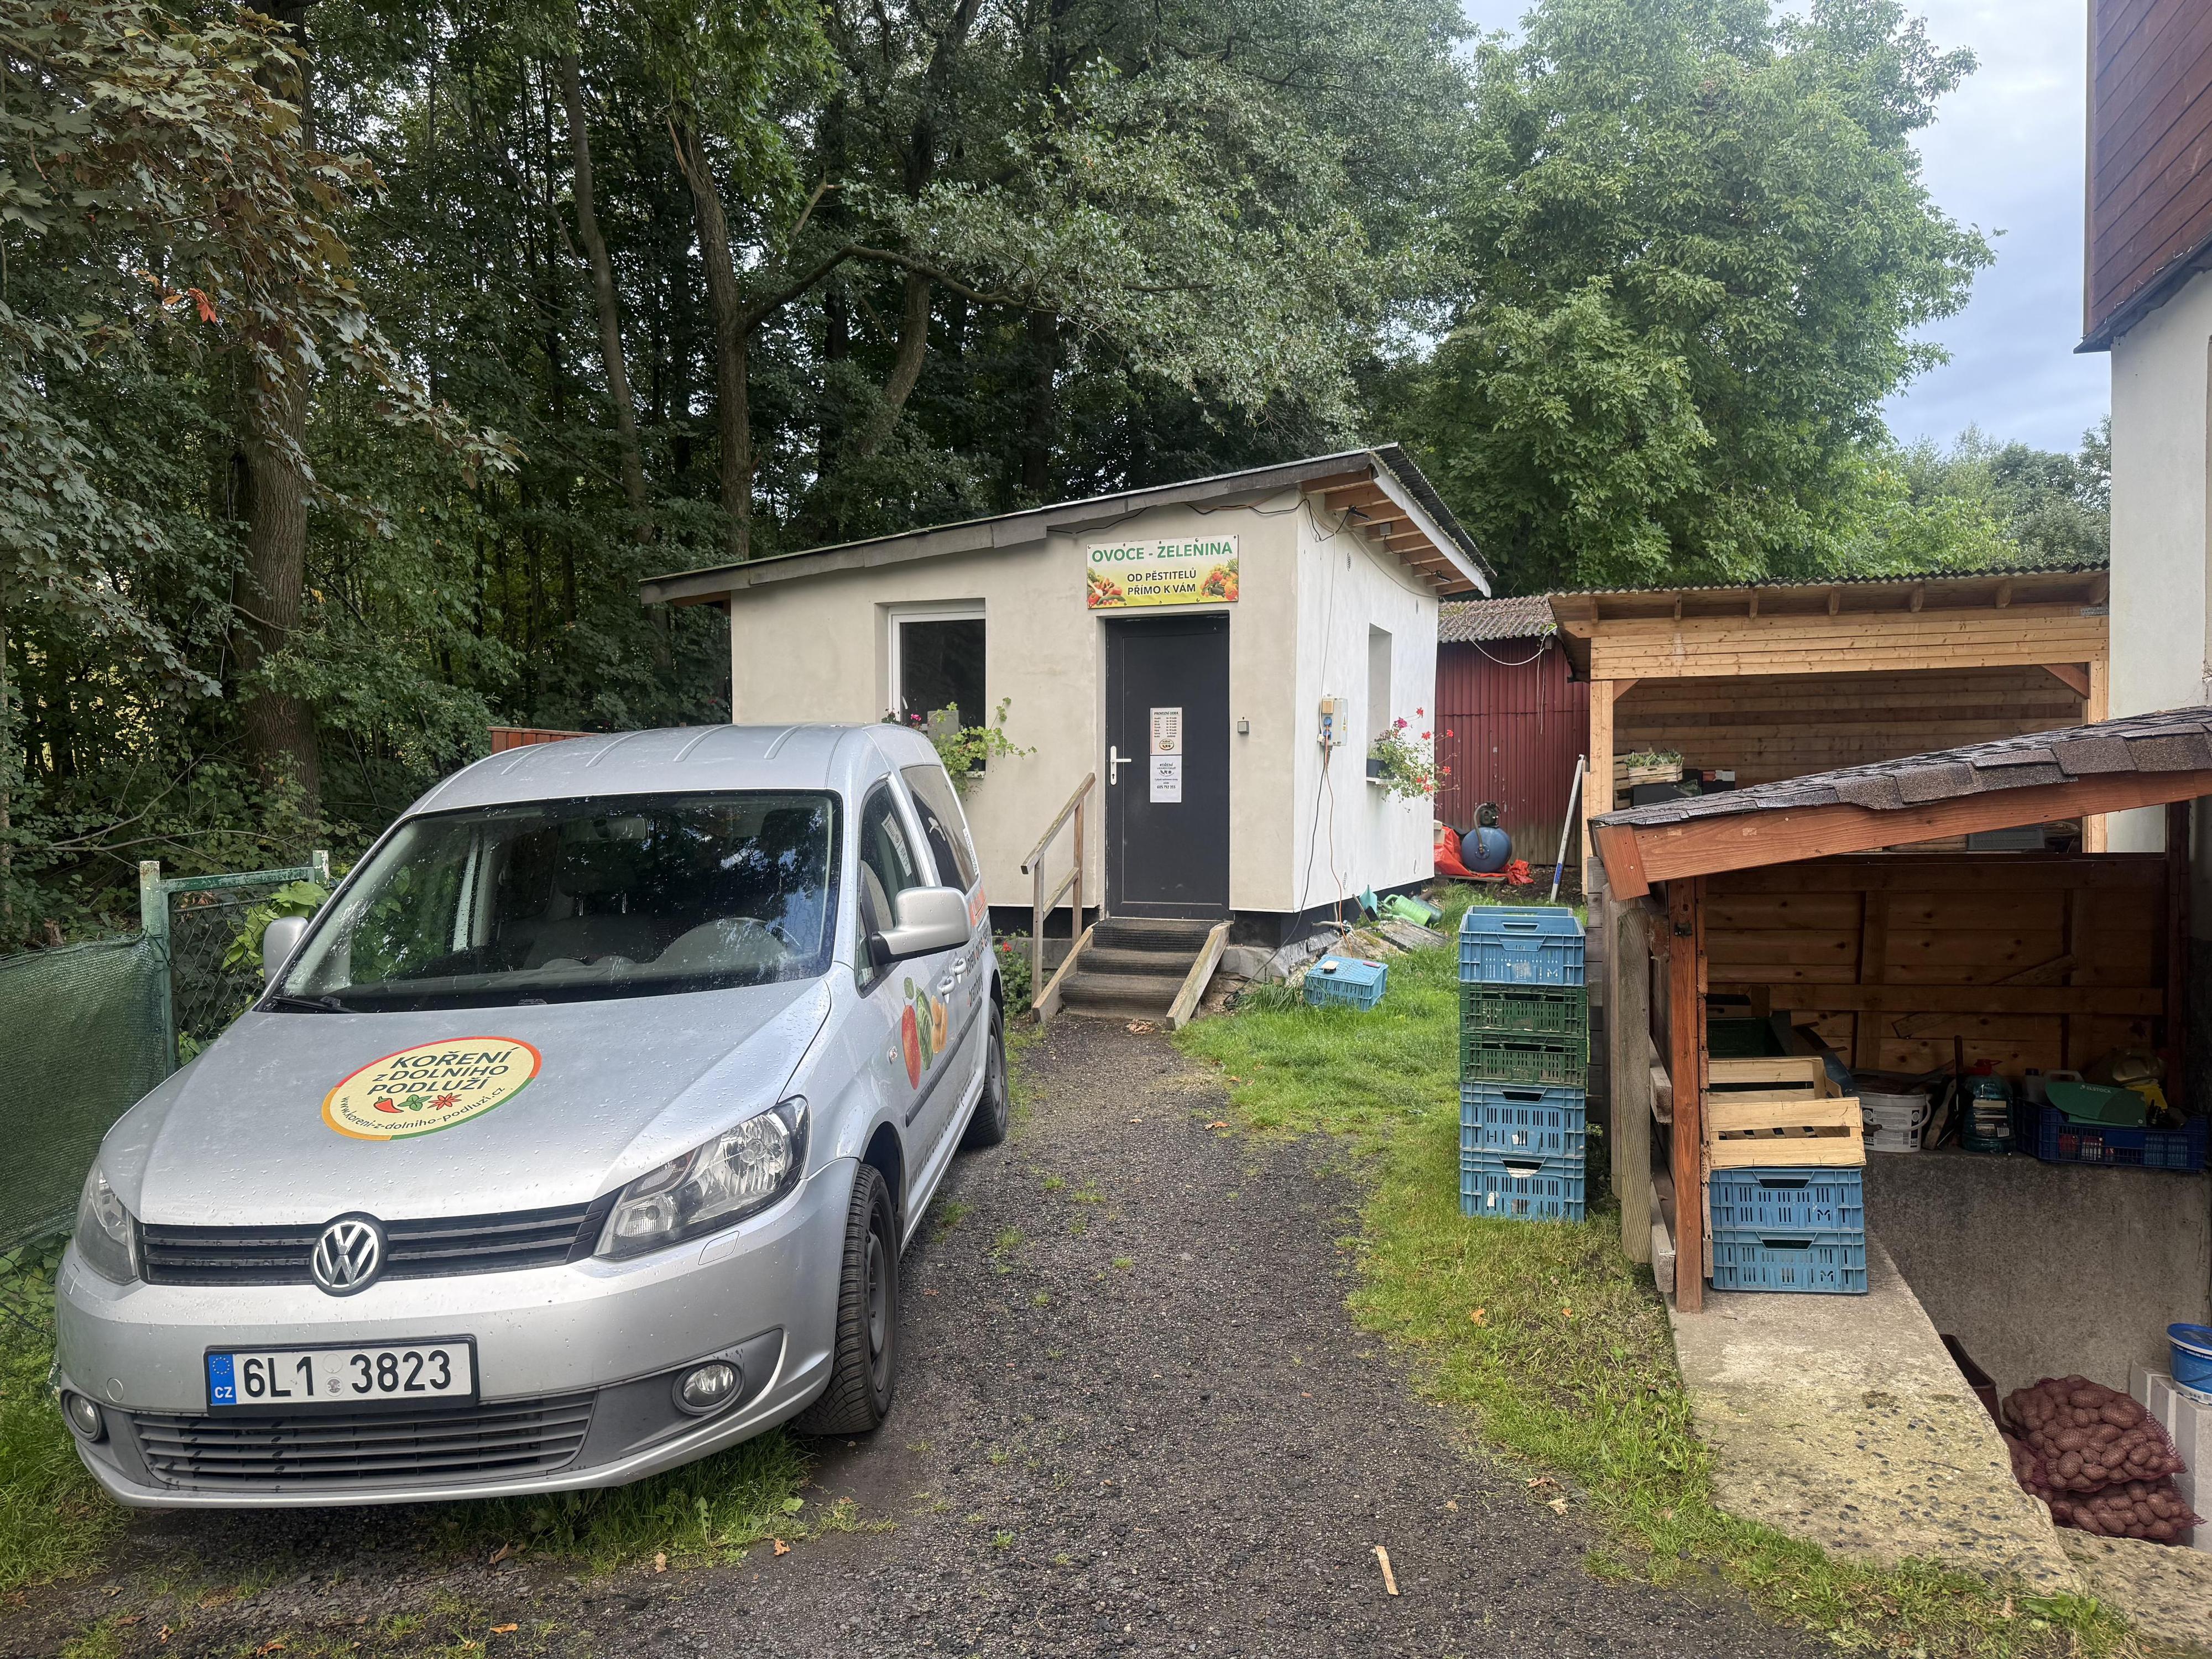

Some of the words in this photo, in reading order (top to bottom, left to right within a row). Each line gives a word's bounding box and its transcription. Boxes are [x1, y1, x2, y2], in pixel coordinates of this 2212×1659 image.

[1092, 547, 1144, 562] OVOCE
[1157, 542, 1233, 559] ZELENINA
[1127, 573, 1142, 582] OD
[1145, 567, 1196, 581] PĚSTITELŮ
[1128, 584, 1161, 596] PŘÍMO
[1164, 585, 1170, 593] K
[1172, 582, 1196, 593] VÁM
[390, 1047, 520, 1069] KOŘENÍ
[388, 1064, 509, 1081] DOLNÍHO
[367, 1076, 490, 1095] PODLUŽÍ
[340, 1087, 505, 1130] www.koreni-z-dolniho-podluzi.cz
[243, 1357, 314, 1397] 6L1
[349, 1349, 451, 1394] 3823
[214, 1386, 233, 1399] CZ
